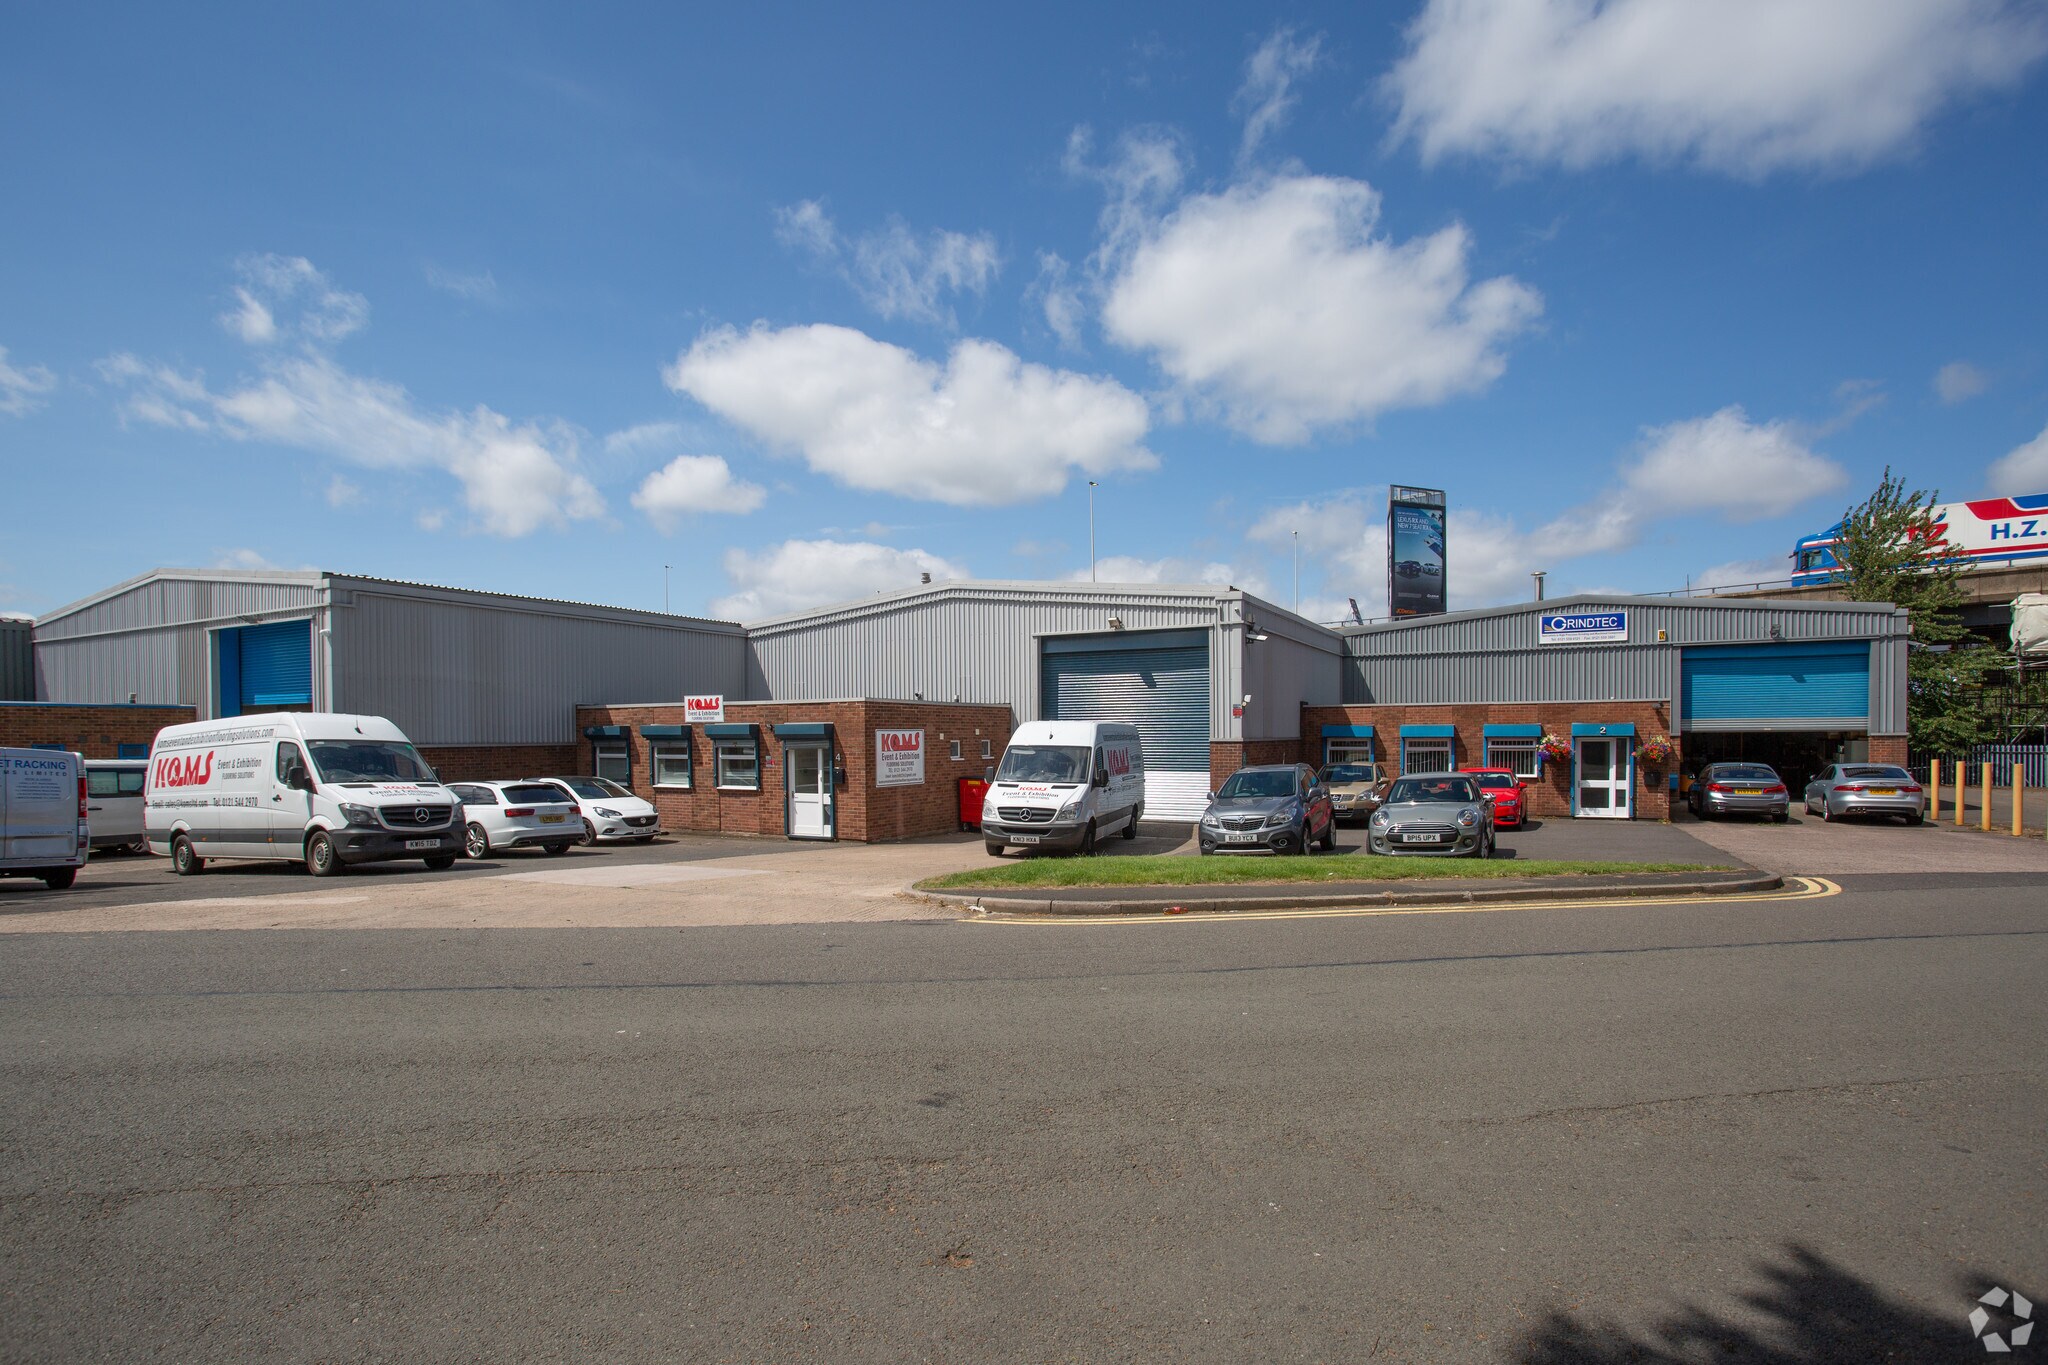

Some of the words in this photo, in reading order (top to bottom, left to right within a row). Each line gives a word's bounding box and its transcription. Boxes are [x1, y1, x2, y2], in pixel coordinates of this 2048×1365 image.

[1991, 520, 2047, 540] H.Z.
[1551, 617, 1617, 631] GRINDTEC
[688, 697, 719, 710] KOMS
[1600, 726, 1606, 734] 2
[881, 732, 920, 751] KOMS
[836, 753, 840, 761] 4
[882, 753, 894, 761] Event
[899, 752, 920, 760] Exhibition
[15, 760, 67, 770] RACKING
[155, 751, 214, 788] KOMS
[218, 759, 231, 770] Event
[232, 760, 236, 769] &
[236, 757, 262, 769] Exhibition
[222, 772, 237, 780] FLOORING
[237, 771, 255, 779] SOLUTIONS
[222, 797, 233, 807] 0121
[234, 797, 244, 807] 544
[245, 796, 258, 807] 2970
